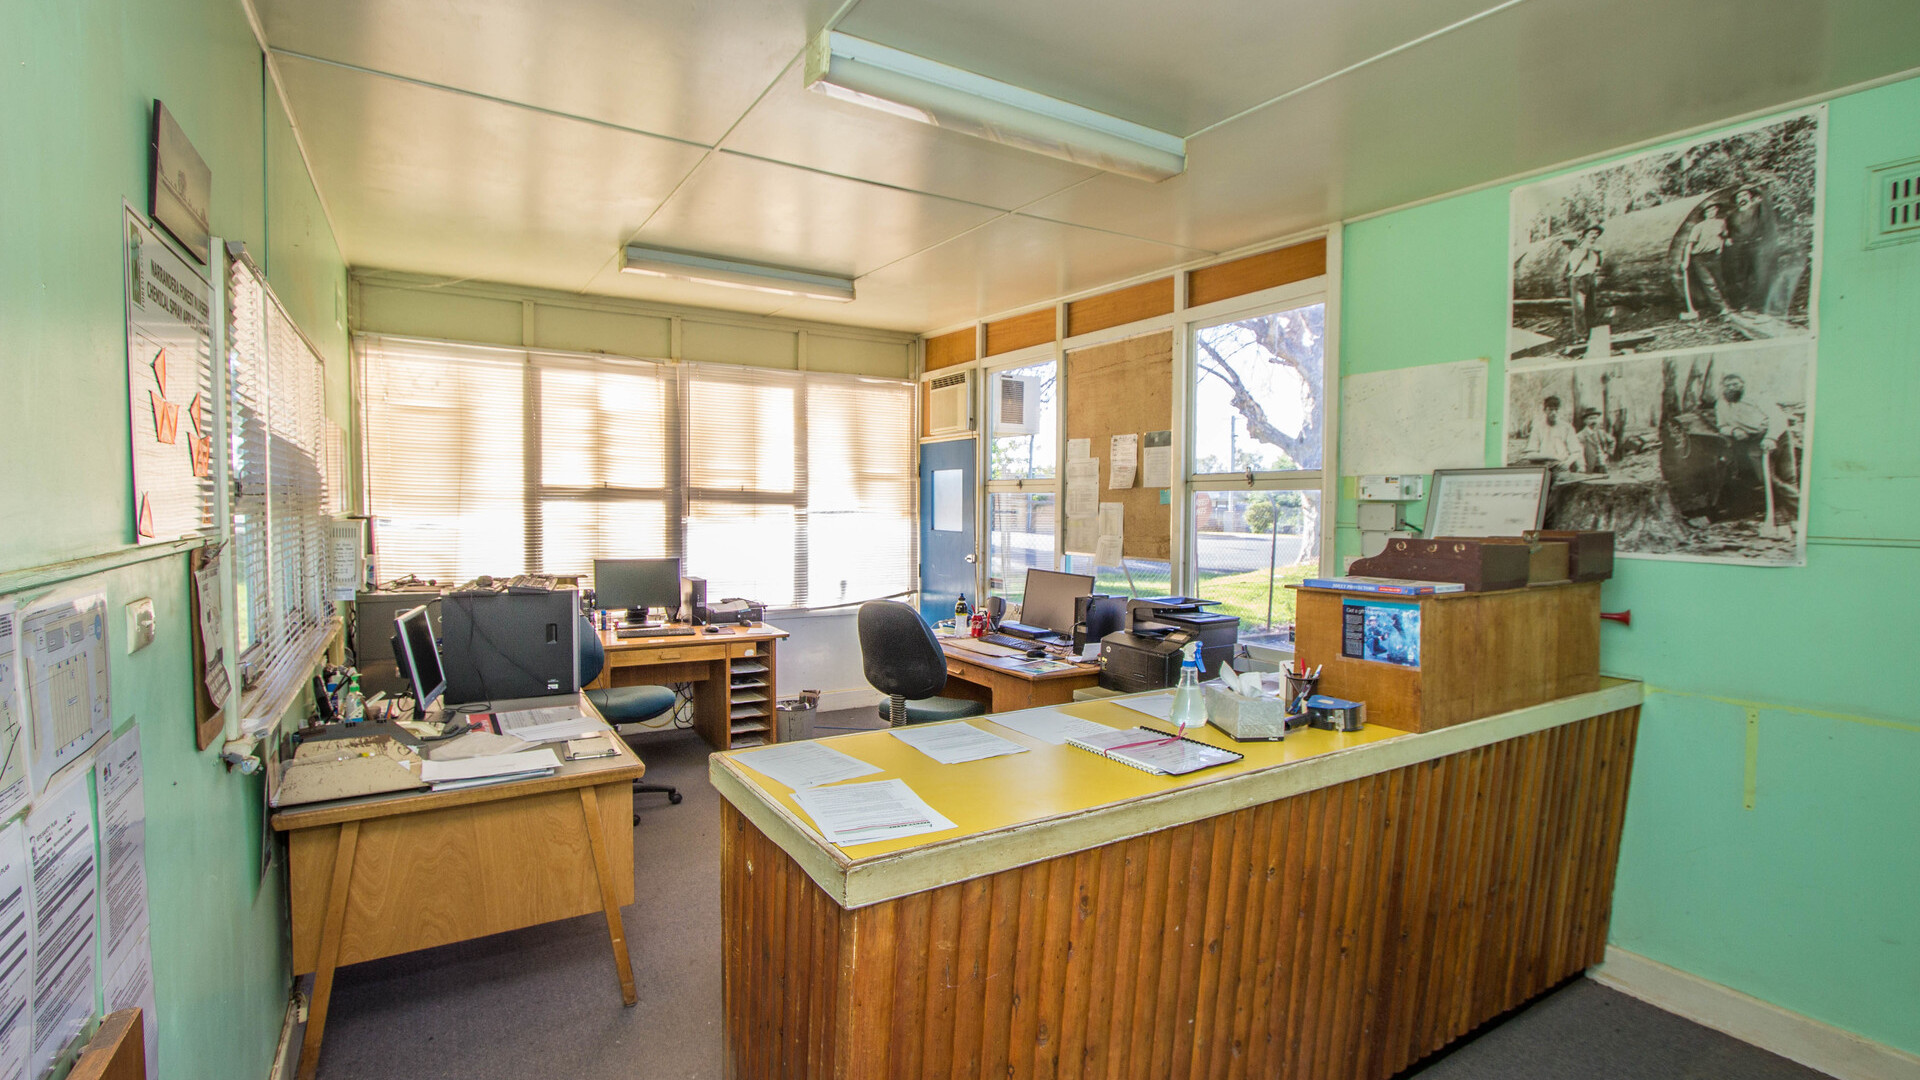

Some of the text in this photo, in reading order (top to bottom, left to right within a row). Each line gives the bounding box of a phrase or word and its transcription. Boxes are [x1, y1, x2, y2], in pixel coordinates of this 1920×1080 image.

[146, 280, 170, 313] CHEMICAL
[169, 298, 183, 322] SPRAY
[150, 258, 180, 297] NARRANDERA
[179, 282, 195, 307] FOREST
